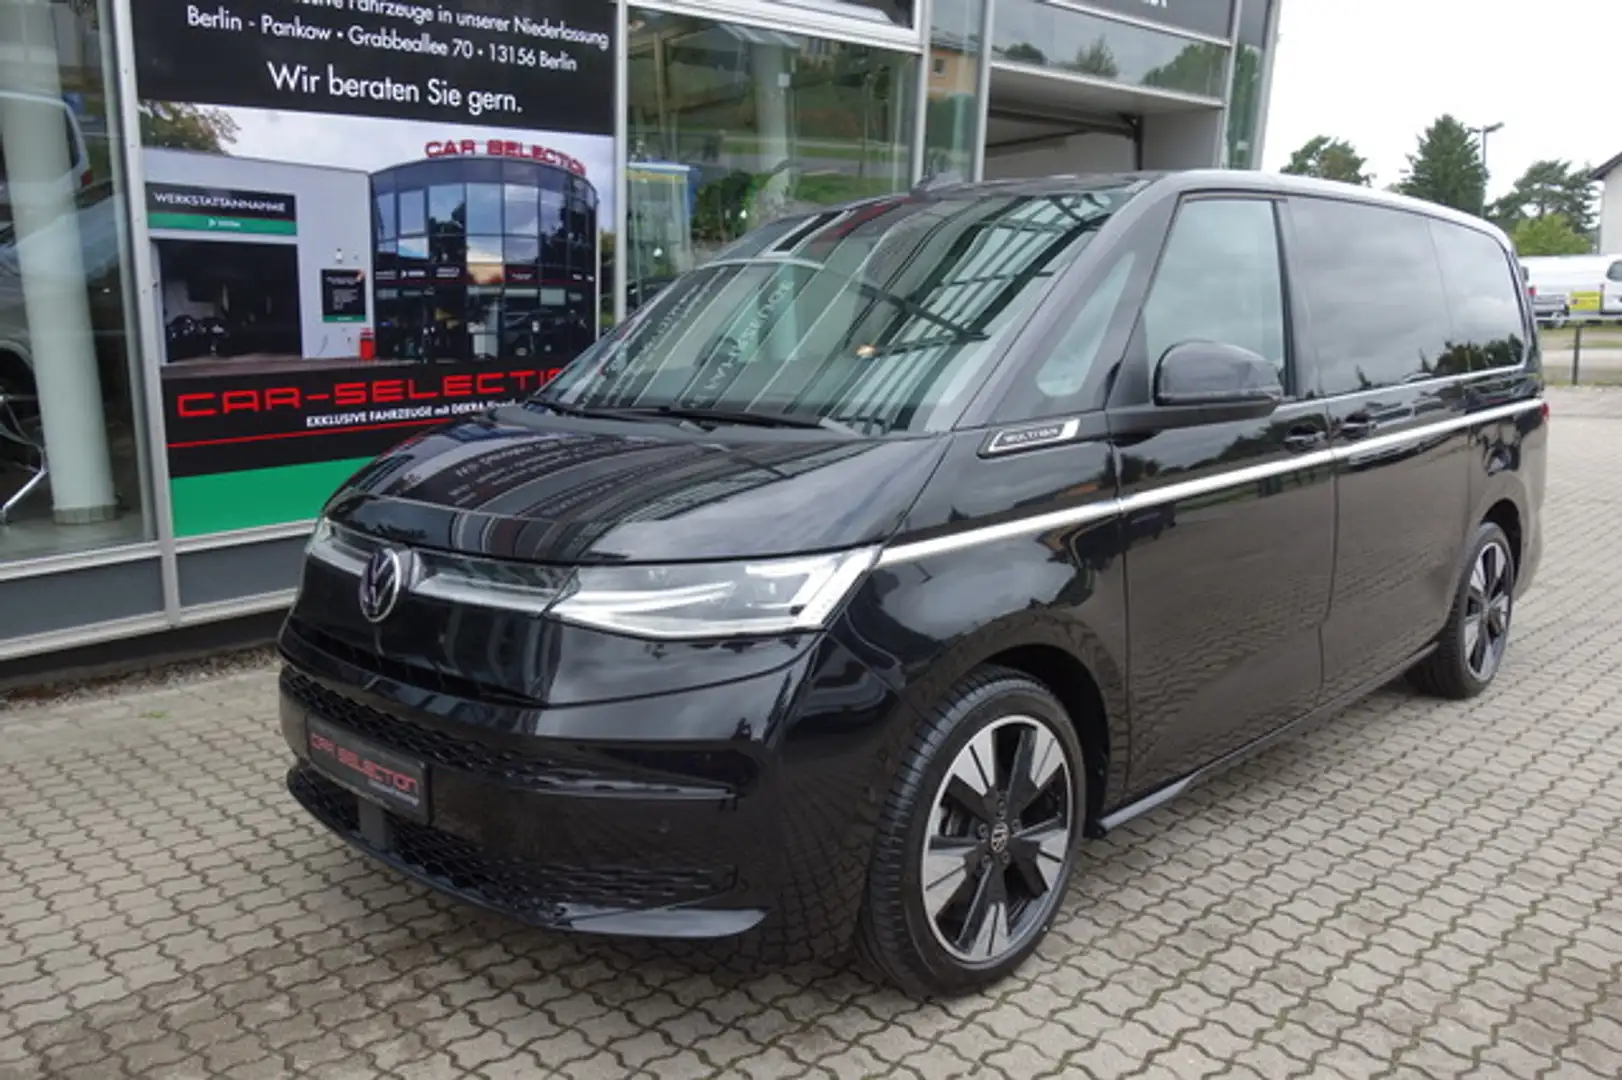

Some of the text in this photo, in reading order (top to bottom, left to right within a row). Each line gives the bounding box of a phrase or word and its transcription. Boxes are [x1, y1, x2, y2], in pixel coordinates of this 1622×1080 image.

[187, 5, 243, 32] Berlin
[260, 14, 332, 41] Pankow
[348, 25, 448, 57] Grabbeallee
[451, 38, 474, 59] 70
[489, 42, 537, 68] 13156
[539, 50, 578, 72] Berlin
[437, 5, 453, 24] in
[456, 13, 510, 32] unserer
[513, 16, 609, 51] Niederlassung
[266, 60, 523, 116] Wir beraten Sie gern.
[425, 139, 476, 158] CAR
